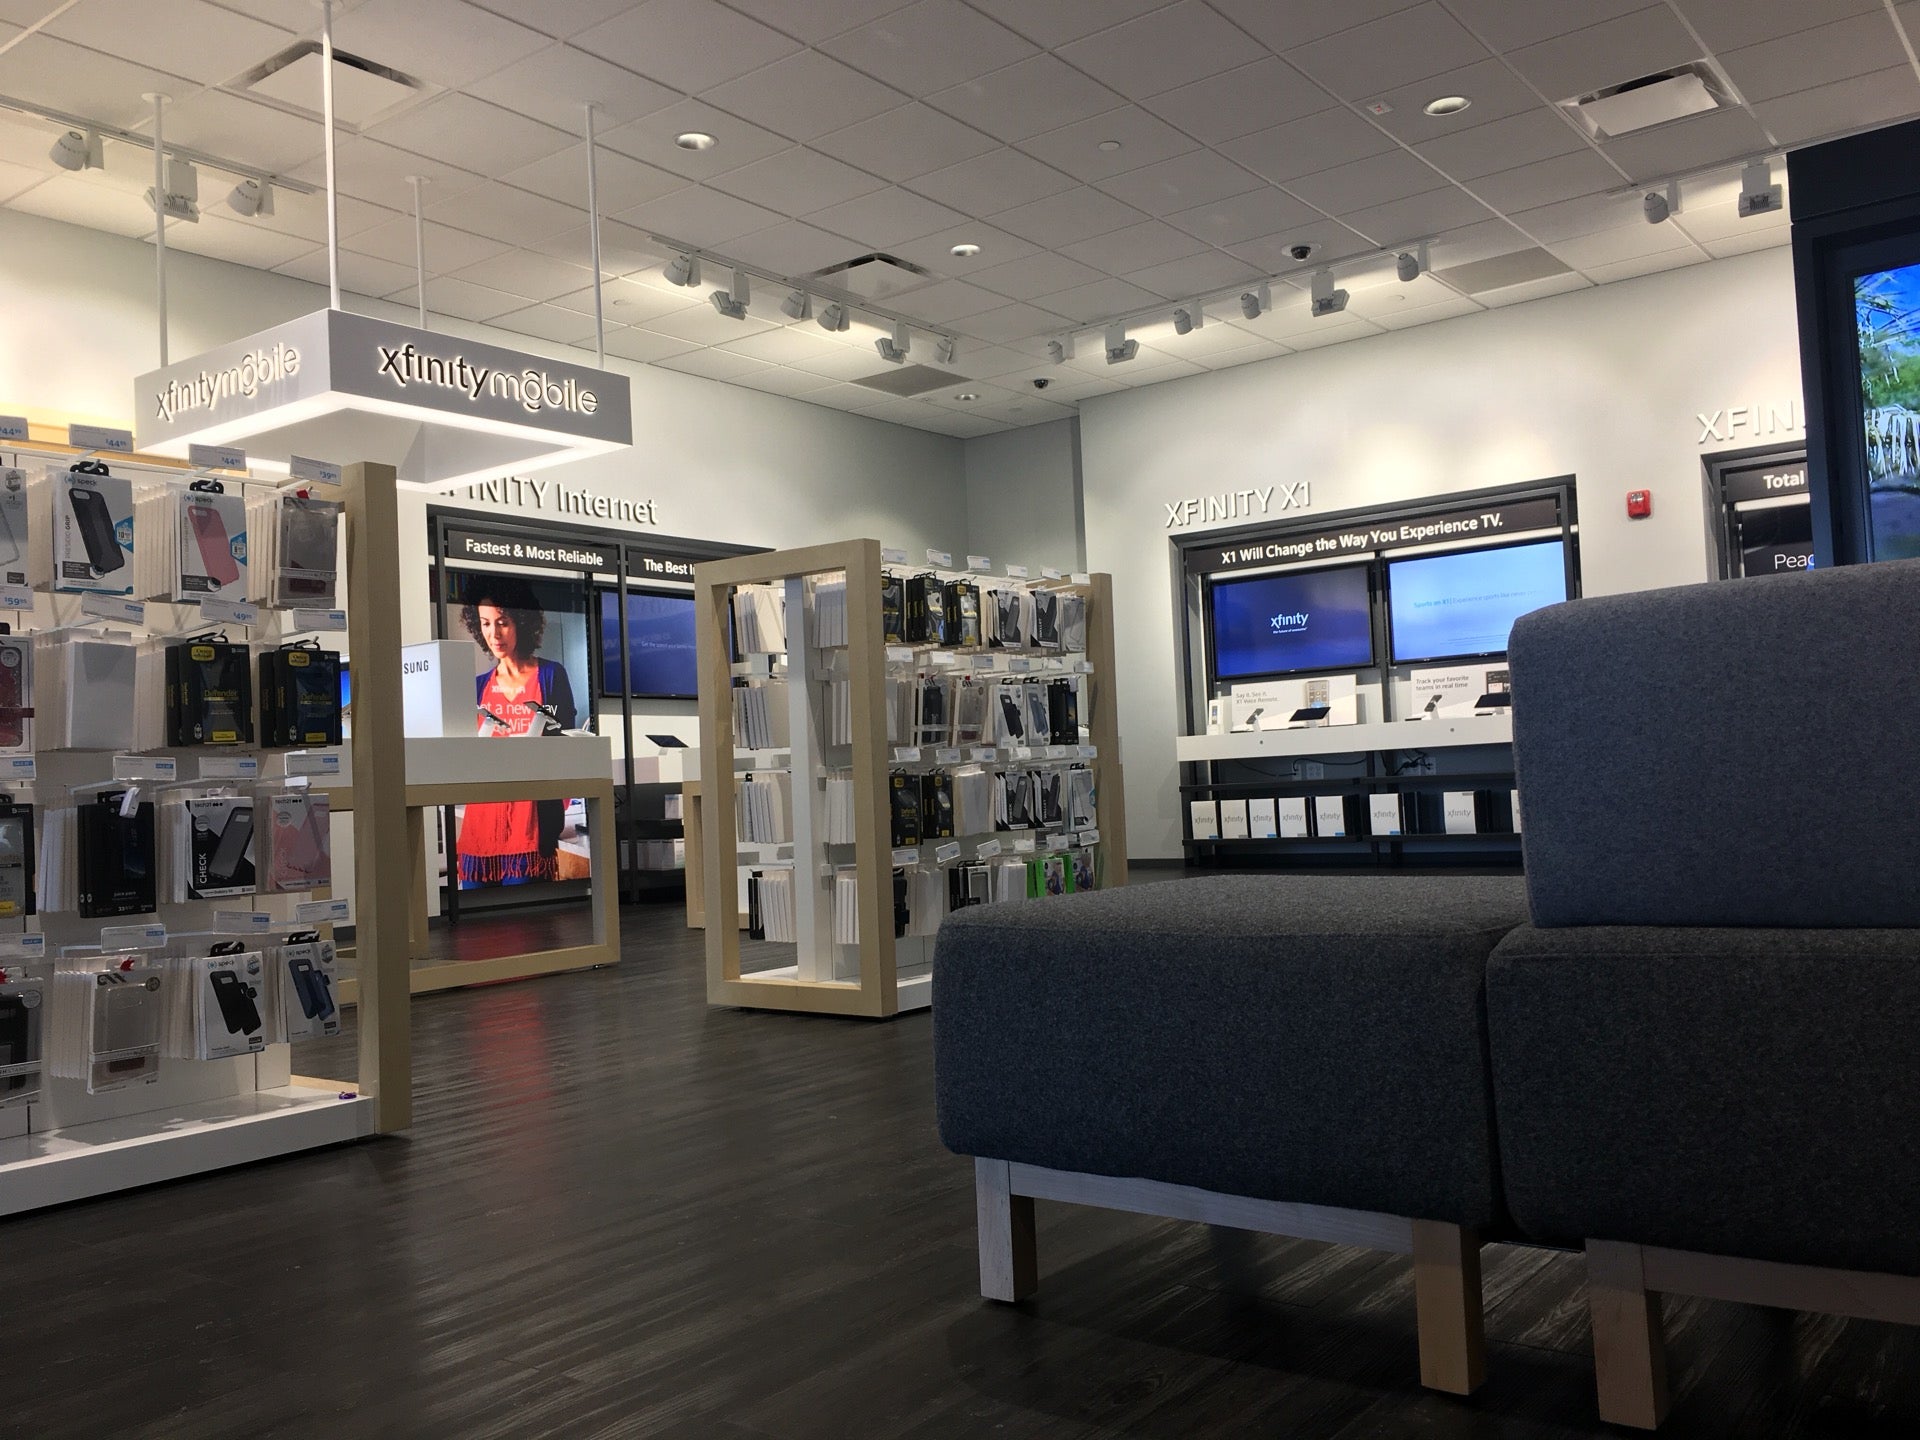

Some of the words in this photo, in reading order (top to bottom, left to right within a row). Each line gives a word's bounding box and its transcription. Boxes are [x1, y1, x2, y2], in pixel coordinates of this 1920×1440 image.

[1696, 400, 1806, 444] XFIN
[1763, 471, 1805, 489] Total
[557, 483, 658, 525] Internet
[1164, 486, 1273, 527] XFINITY
[1280, 481, 1311, 510] X1
[466, 538, 510, 557] Fastest
[513, 545, 524, 558] &
[526, 548, 555, 562] Most
[558, 550, 603, 566] Reliable
[1221, 551, 1237, 564] X1
[1239, 546, 1264, 562] Will
[1265, 542, 1313, 558] Change
[1315, 538, 1337, 552] the
[1339, 534, 1368, 550] Way
[1370, 529, 1398, 545] You
[1400, 518, 1478, 542] Experience
[1480, 512, 1503, 527] TV.
[644, 558, 663, 573] The
[665, 561, 687, 575] Best
[1270, 612, 1309, 629] xfinity
[403, 660, 429, 674] SUNG
[495, 704, 503, 715] a
[507, 703, 531, 715] new
[543, 704, 558, 716] ay
[199, 852, 207, 884] CHECK
